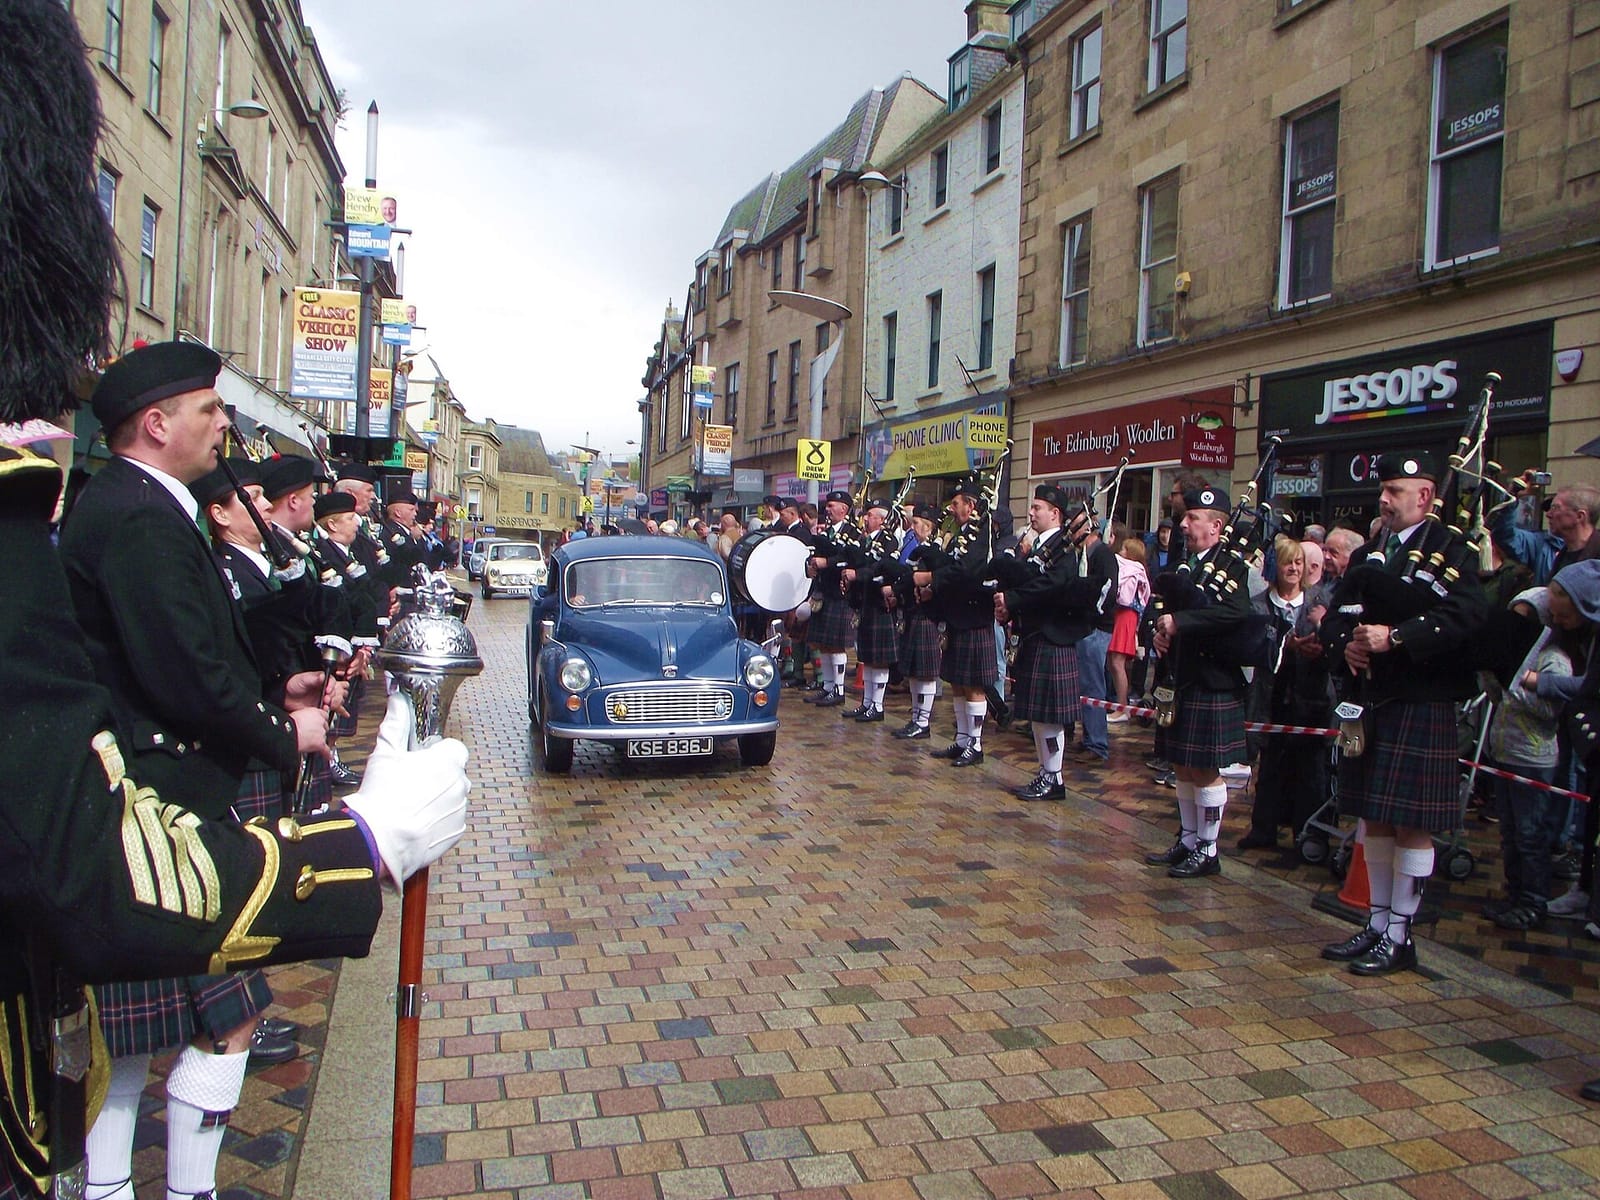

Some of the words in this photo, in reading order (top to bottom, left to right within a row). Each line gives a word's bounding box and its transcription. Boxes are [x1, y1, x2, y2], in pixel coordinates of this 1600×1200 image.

[1448, 104, 1500, 140] JESSOPS
[1297, 171, 1334, 196] JESSOPS
[346, 191, 371, 202] Drew
[346, 201, 379, 215] Hendry
[349, 238, 390, 249] MOUNTAIN
[302, 292, 318, 301] FREE
[300, 304, 356, 321] CLASSIC
[297, 320, 357, 337] VEHICLE
[305, 336, 347, 352] SHOW
[1315, 359, 1458, 425] JESSOPS
[369, 400, 383, 410] OW
[1504, 396, 1544, 408] PHOTOGRAPHY
[969, 421, 1005, 432] PHONE
[706, 431, 731, 440] CLASSIC
[894, 427, 926, 450] PHONE
[928, 419, 963, 445] CLINIC
[970, 432, 1003, 444] CLINIC
[1043, 436, 1061, 457] The
[1065, 426, 1120, 455] Edinburgh
[1126, 418, 1176, 446] Woollen
[1204, 431, 1217, 441] The
[1193, 441, 1225, 453] Edinburgh
[1190, 453, 1214, 463] Woollen
[1215, 455, 1229, 464] Mill
[802, 471, 827, 479] HENDRY
[1269, 478, 1319, 499] JESSOPS
[629, 741, 663, 756] KSE
[667, 738, 711, 755] 836J
